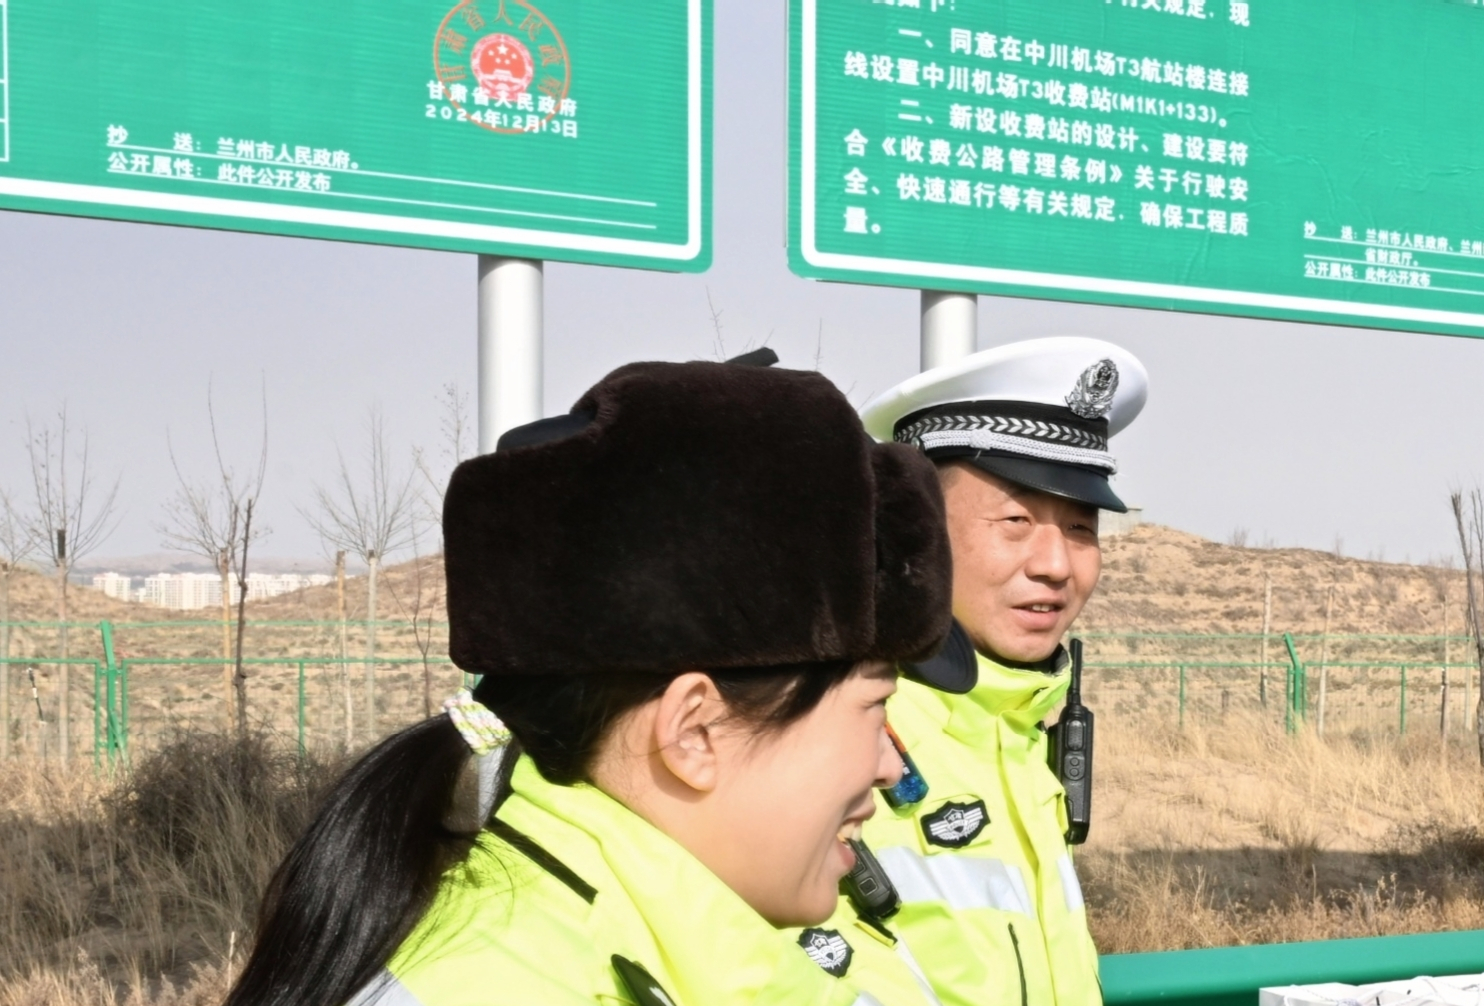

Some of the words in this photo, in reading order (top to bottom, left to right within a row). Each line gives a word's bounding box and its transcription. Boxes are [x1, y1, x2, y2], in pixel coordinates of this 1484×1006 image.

[898, 27, 1249, 97] 一、同意在中川机场T3航站楼连接
[425, 105, 578, 138] 2024年12月13日
[427, 80, 577, 118] 甘肃省人民政府
[897, 99, 1249, 166] 二、新设收费站的设计、建设要符
[844, 129, 1249, 201] 合《收费公路管理条例》关于行驶安
[844, 207, 882, 235] 量。
